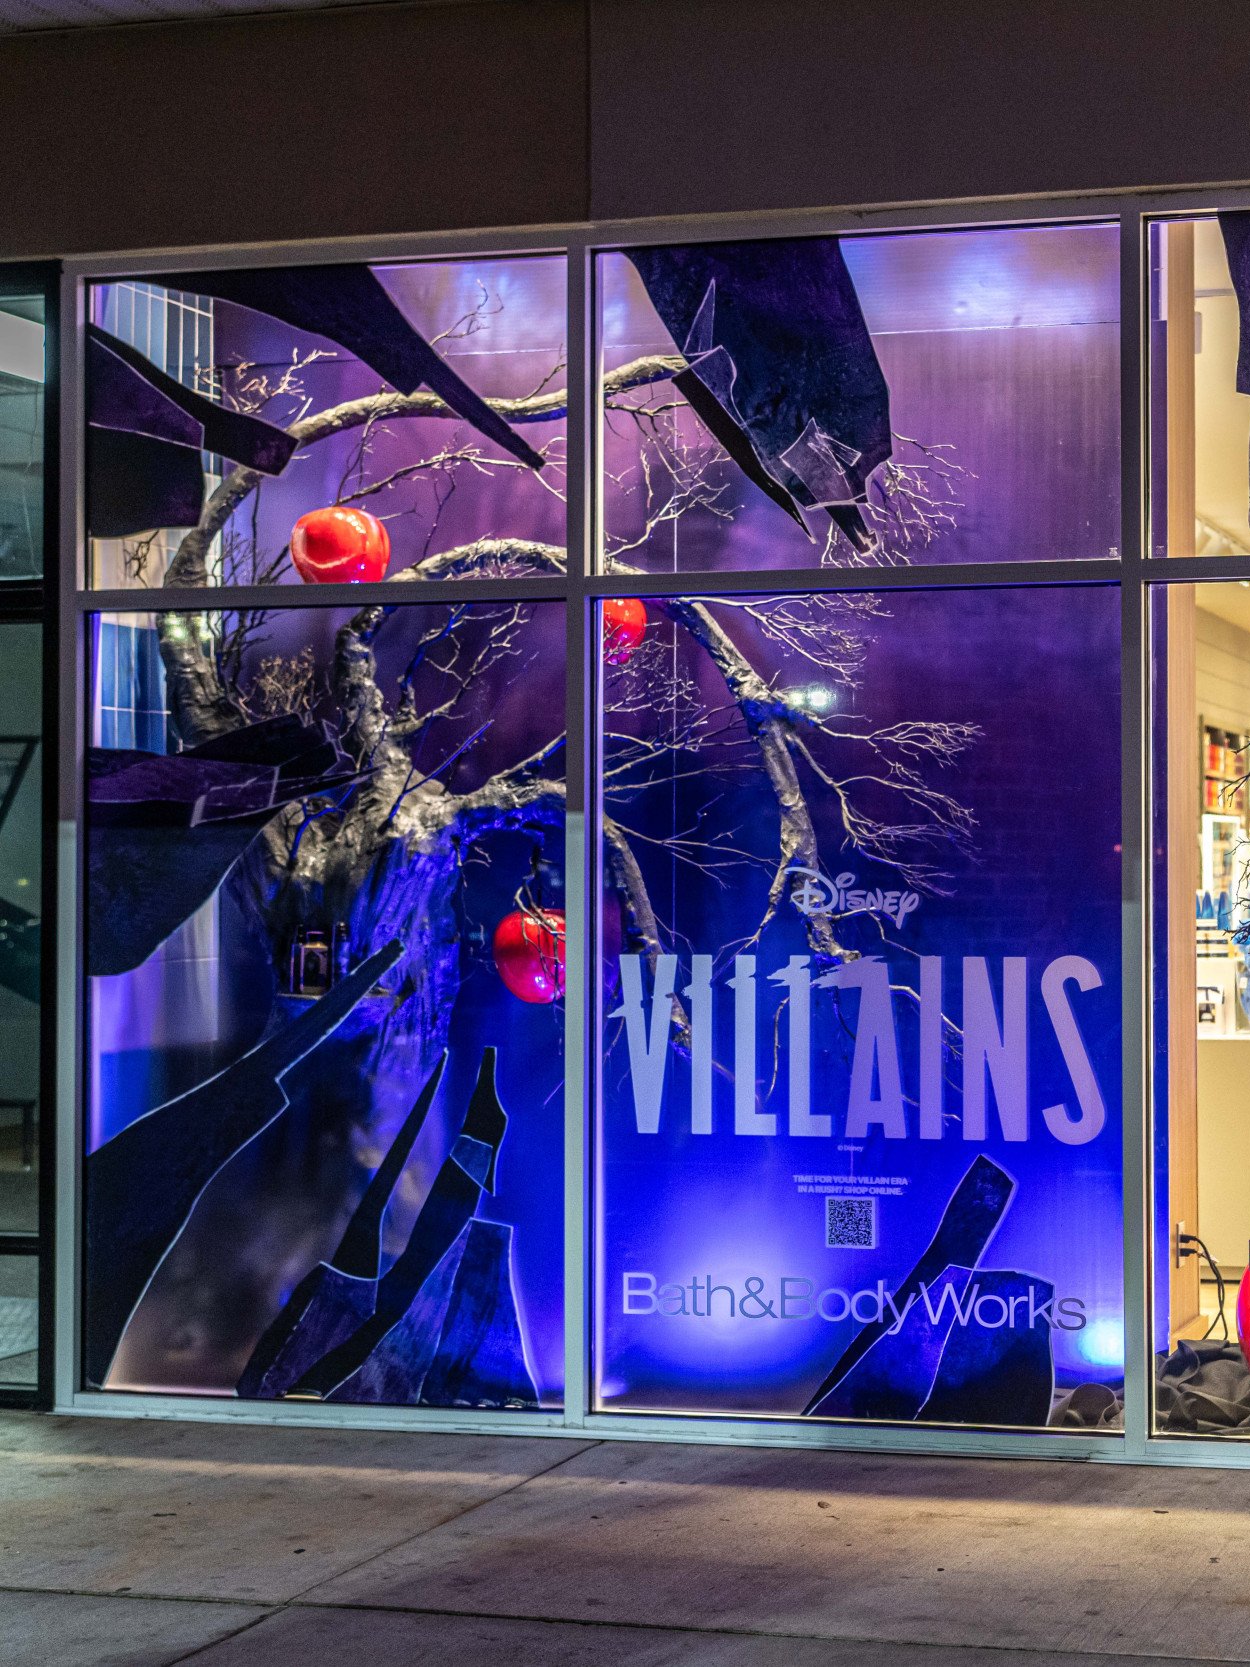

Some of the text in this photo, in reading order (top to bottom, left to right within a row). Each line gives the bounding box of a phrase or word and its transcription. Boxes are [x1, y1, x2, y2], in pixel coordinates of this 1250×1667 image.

[607, 953, 1106, 1145] VILLAINS
[793, 1174, 908, 1186] TIME FOR YOUR VILLAIN ERA
[797, 1185, 807, 1194] IN
[807, 1185, 814, 1194] A
[815, 1185, 843, 1195] RUSH?
[843, 1186, 868, 1195] SHOP
